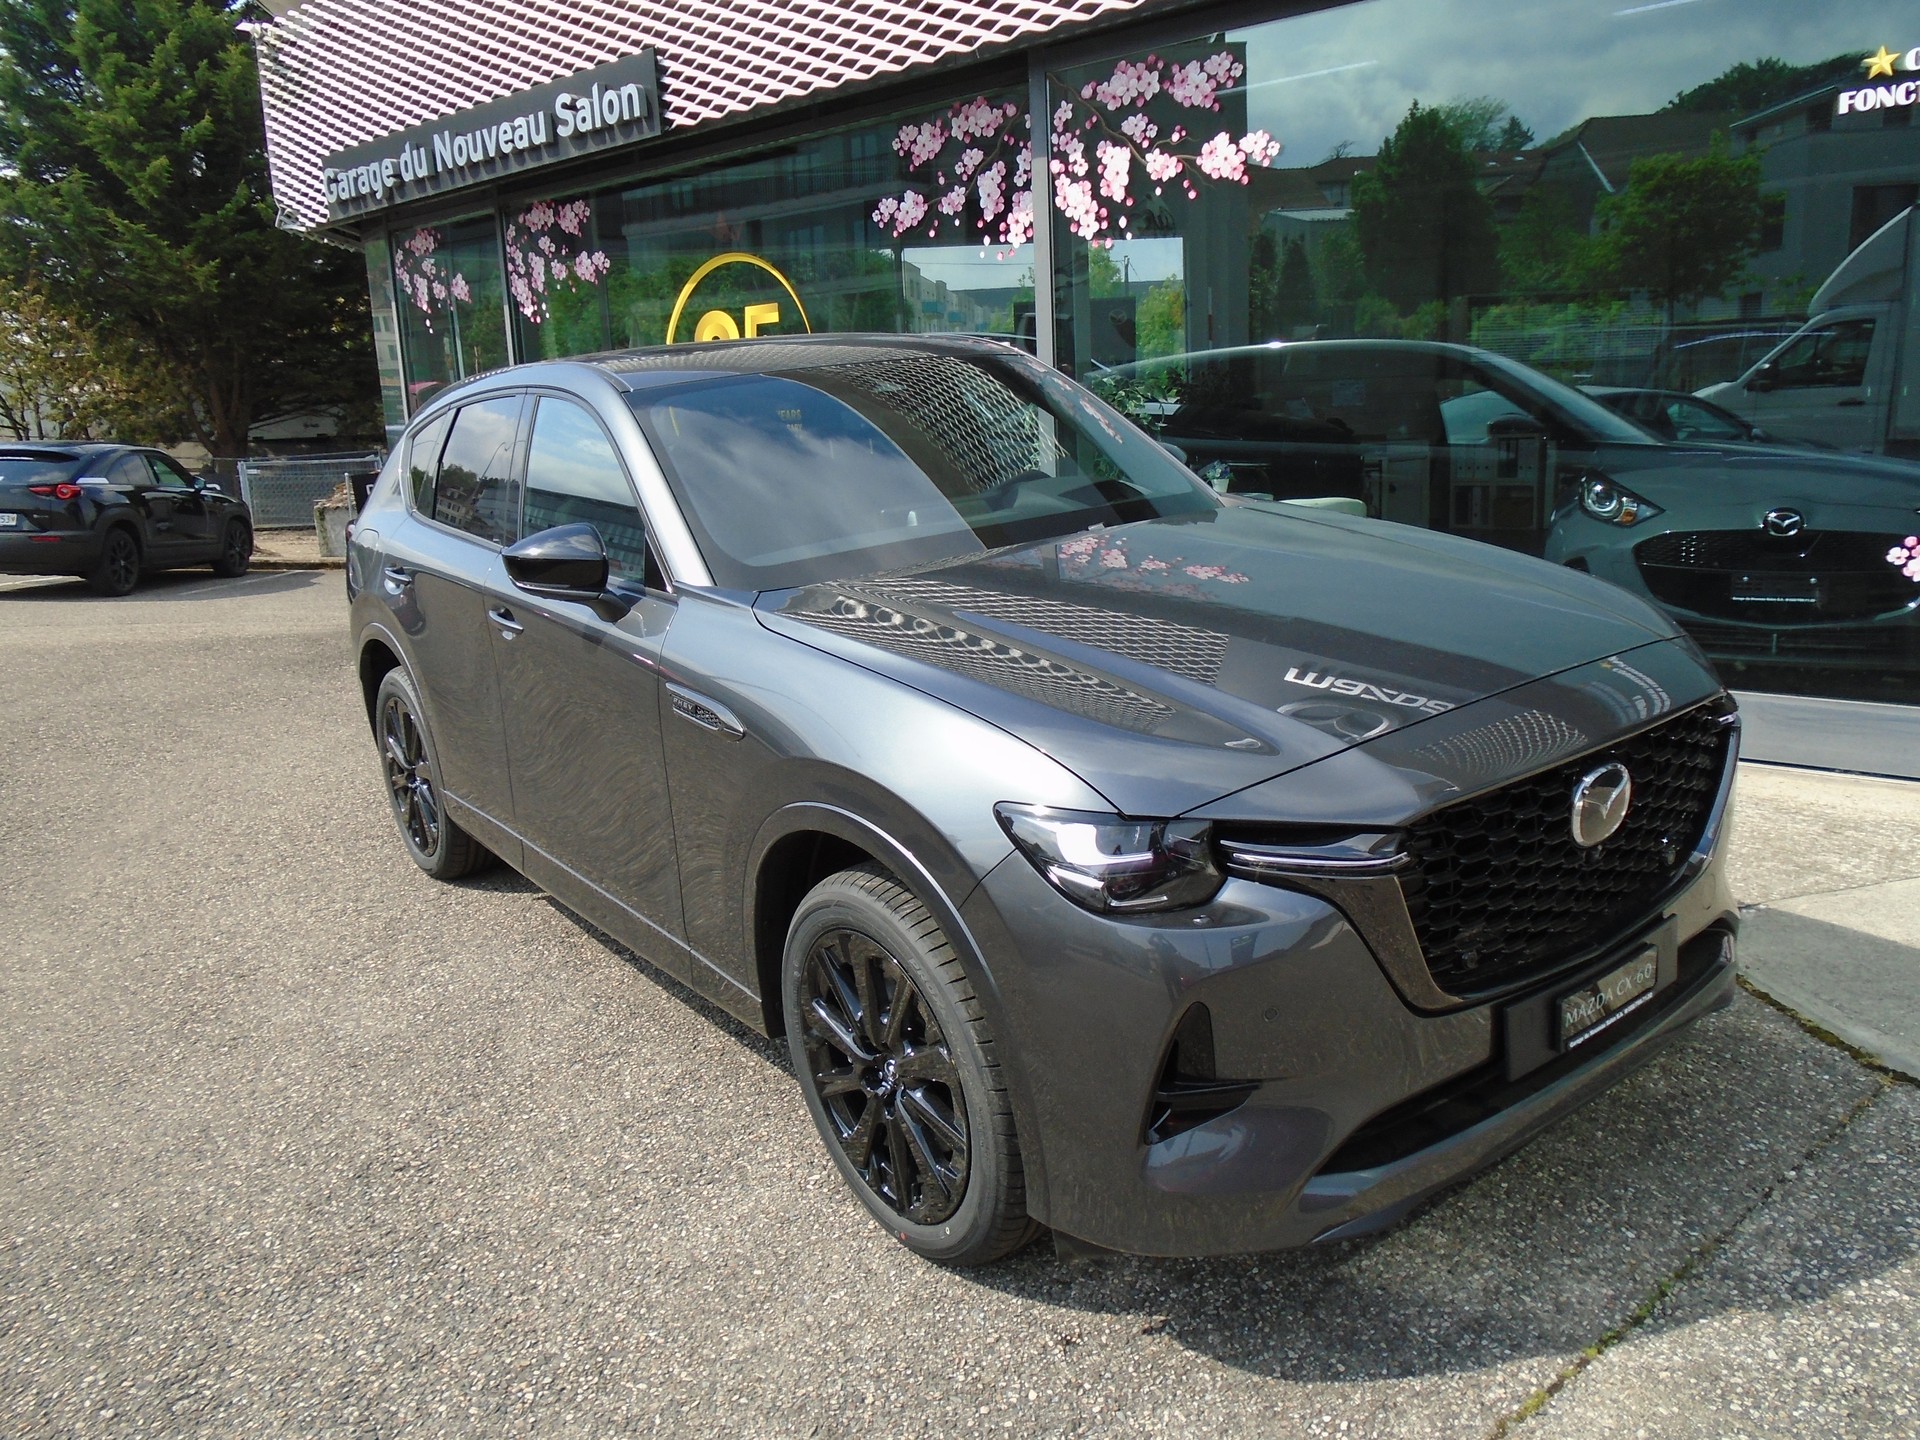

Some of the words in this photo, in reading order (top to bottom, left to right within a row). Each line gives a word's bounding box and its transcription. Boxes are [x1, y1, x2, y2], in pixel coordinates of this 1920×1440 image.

[1838, 80, 1920, 115] FONC
[323, 158, 395, 203] Garage
[400, 141, 428, 183] du
[433, 110, 547, 172] Nouveau
[555, 82, 642, 138] Salon
[1565, 987, 1614, 1028] MAZDA
